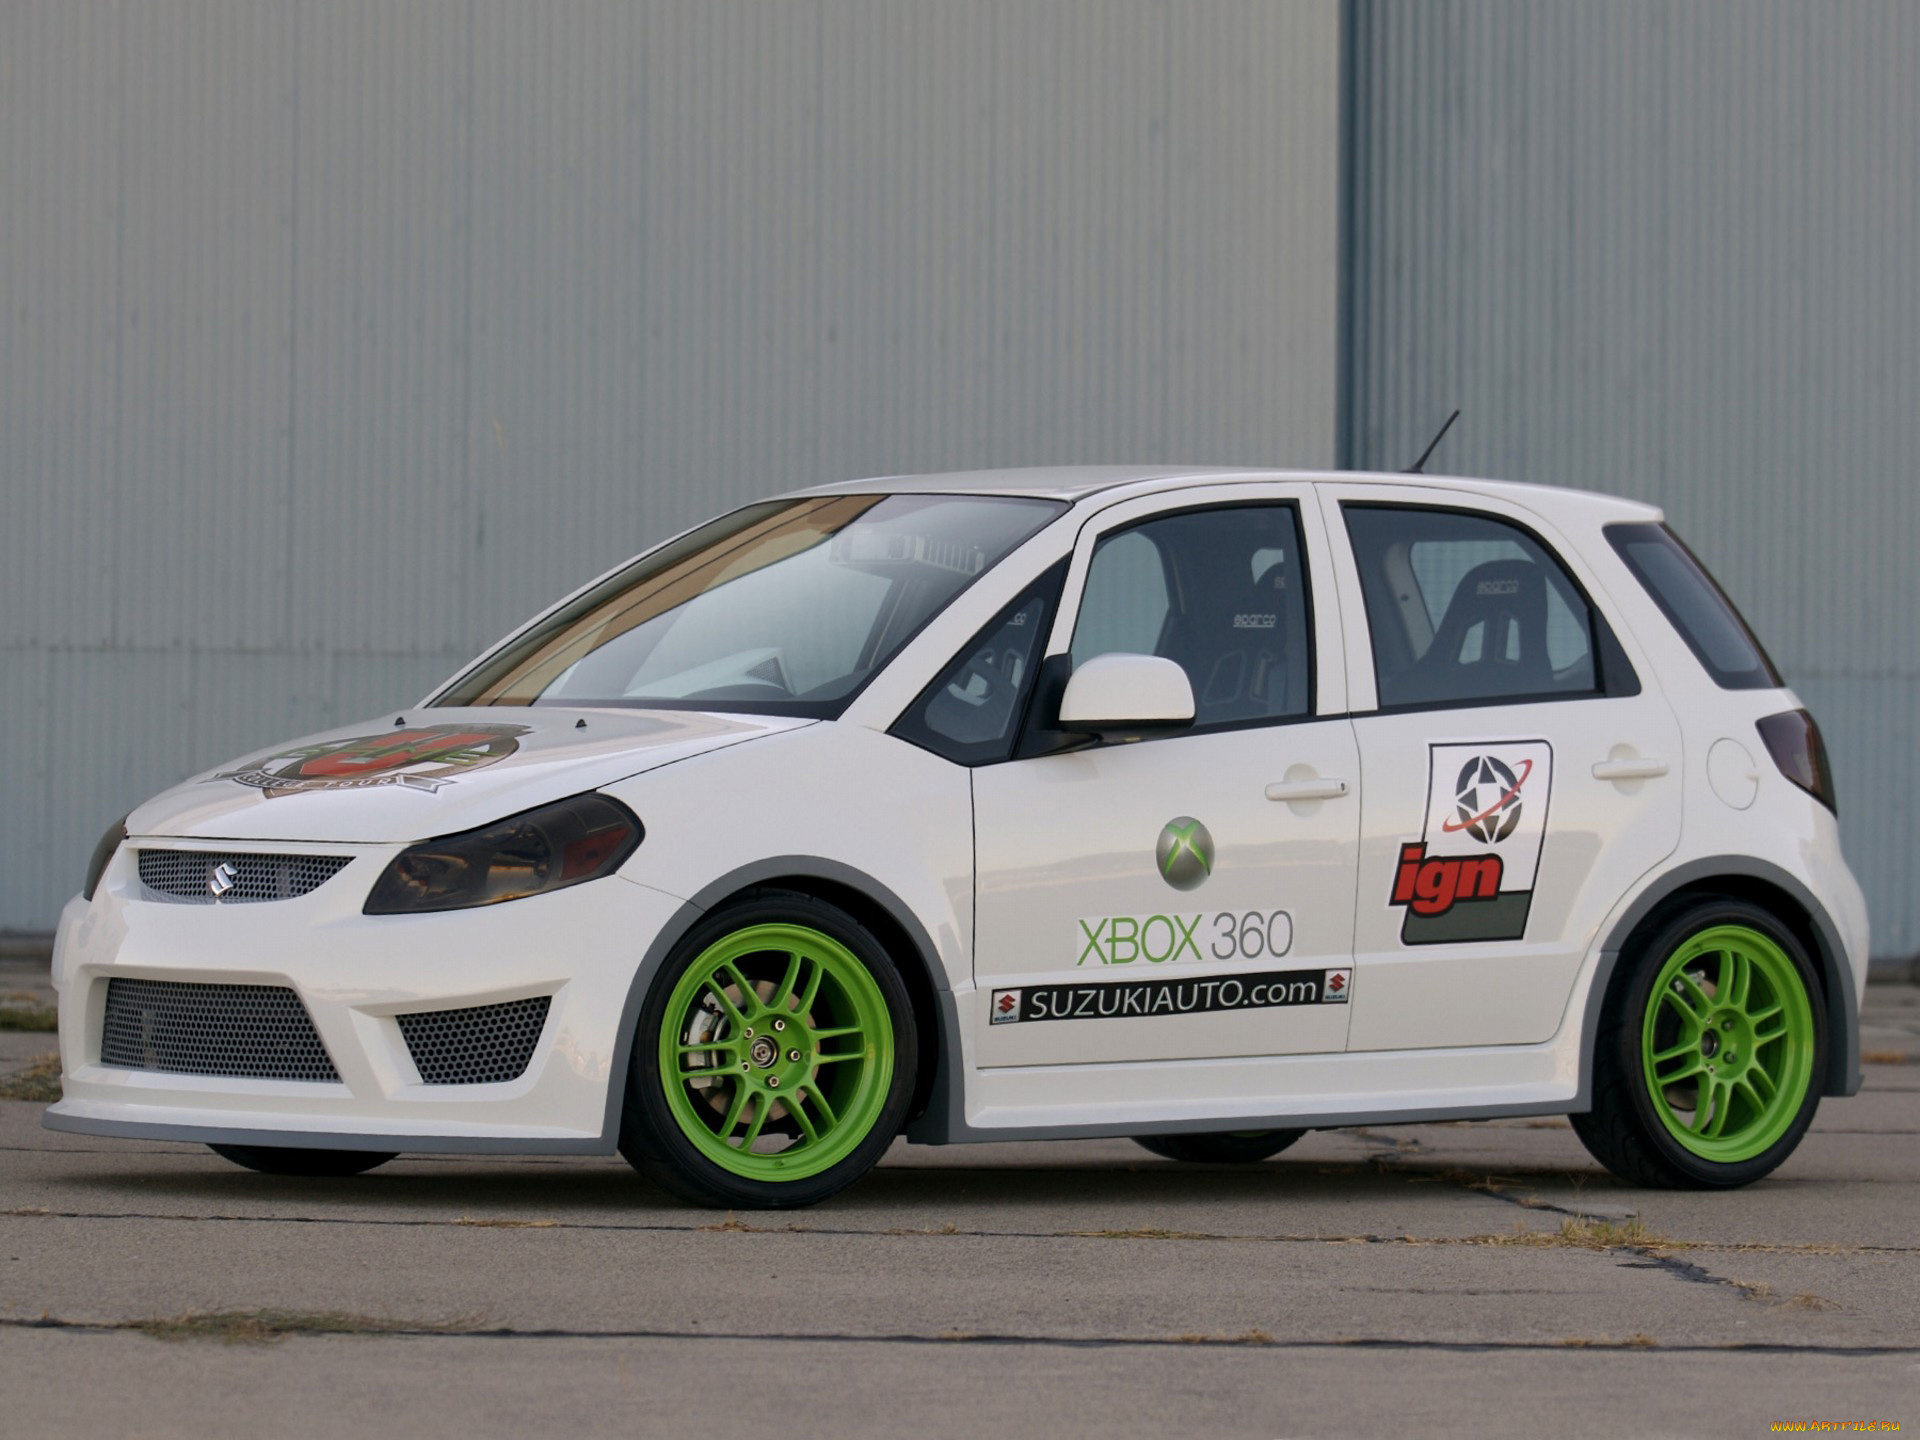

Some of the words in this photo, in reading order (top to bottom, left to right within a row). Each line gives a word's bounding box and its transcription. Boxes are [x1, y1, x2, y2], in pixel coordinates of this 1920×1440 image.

[1233, 613, 1276, 627] sparco
[324, 778, 392, 787] TOUR
[1392, 845, 1502, 916] ign
[1076, 914, 1203, 966] XBOX
[1211, 910, 1293, 960] 360
[1029, 979, 1317, 1019] SUZUKIAUTO.com
